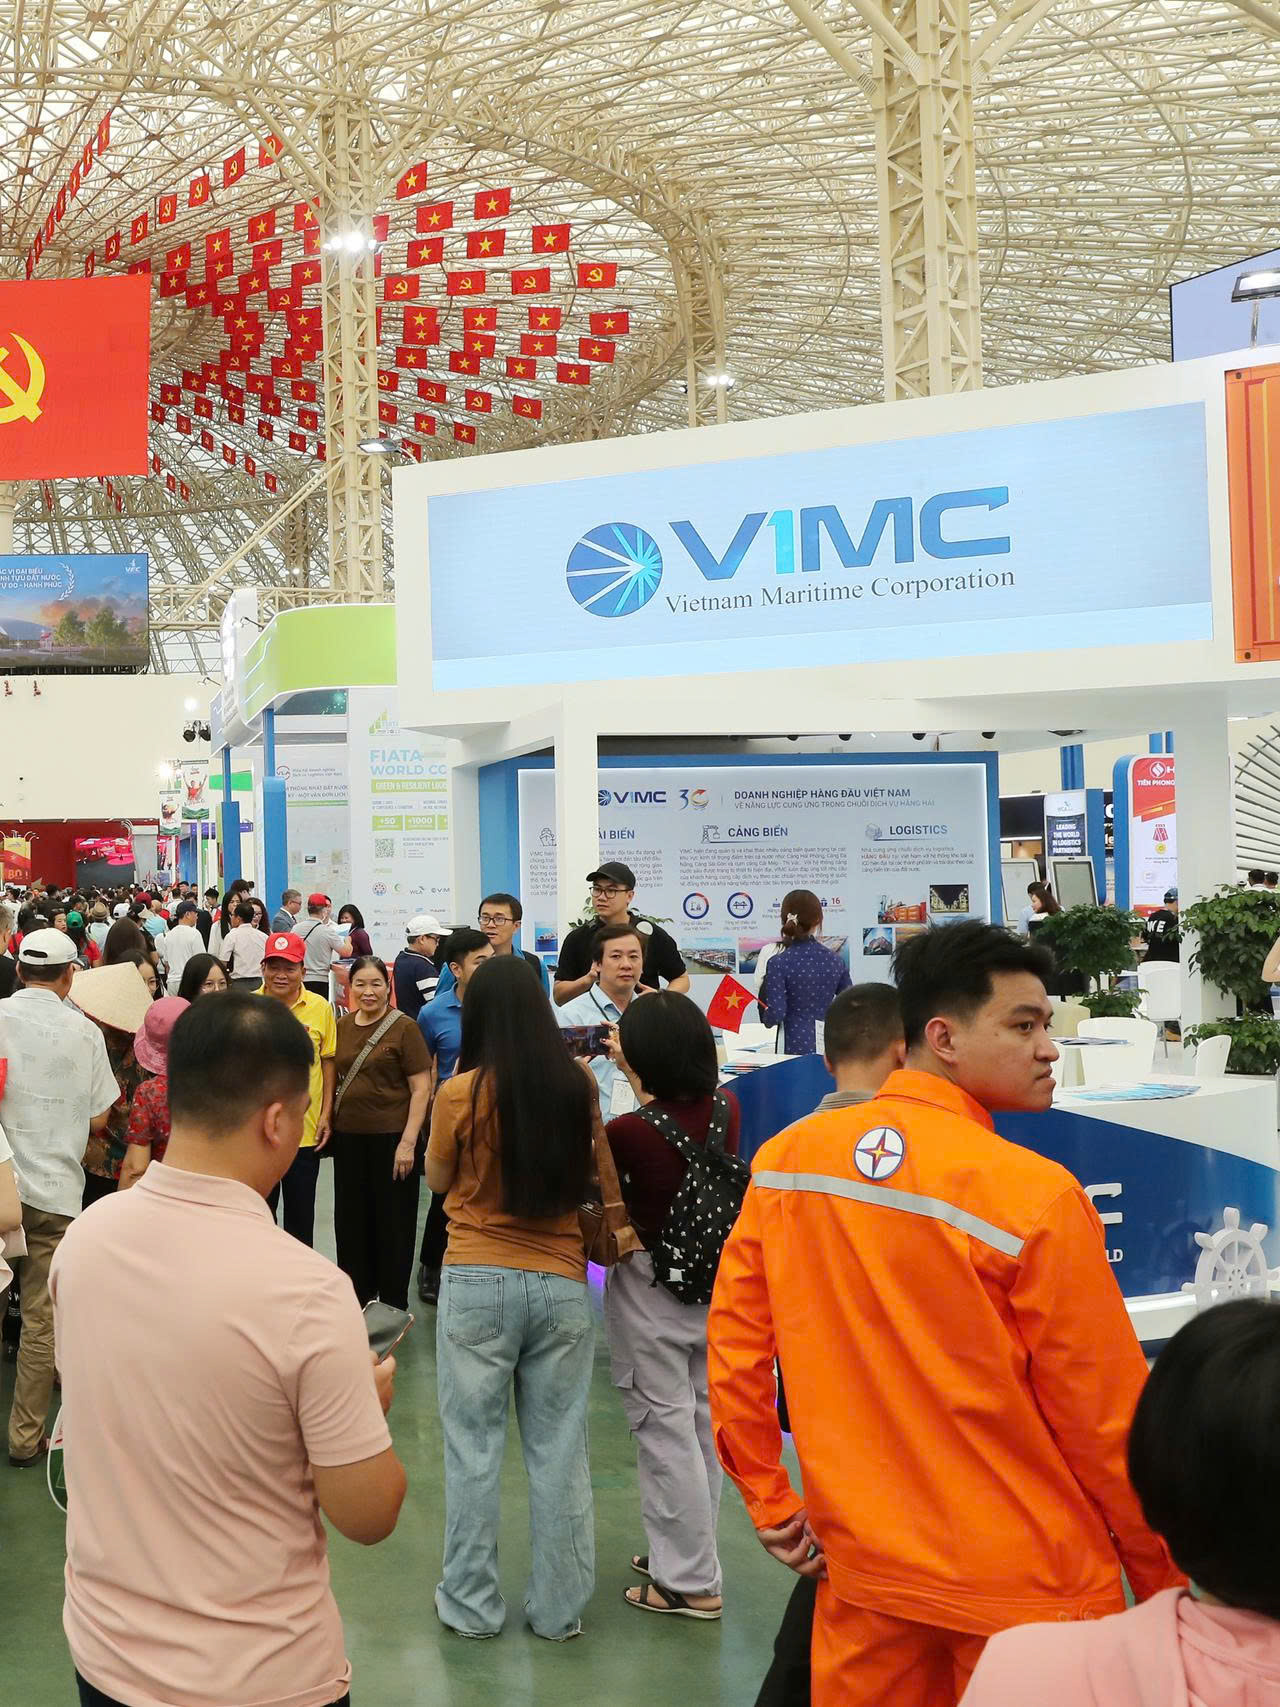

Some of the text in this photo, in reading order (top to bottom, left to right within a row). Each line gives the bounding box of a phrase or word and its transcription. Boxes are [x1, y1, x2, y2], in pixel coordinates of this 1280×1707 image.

[665, 568, 1016, 615] Vietnam Maritime Corporation
[370, 749, 423, 762] FIATA
[370, 764, 424, 776] WORLD
[734, 787, 911, 800] DOANH NGHIỆP HÀNG ĐẦU VIỆT NAM
[609, 826, 635, 839] BIỂN
[728, 824, 788, 837] CẢNG BIỂN
[889, 825, 948, 835] LOGISTICS
[1056, 823, 1077, 831] LEADING
